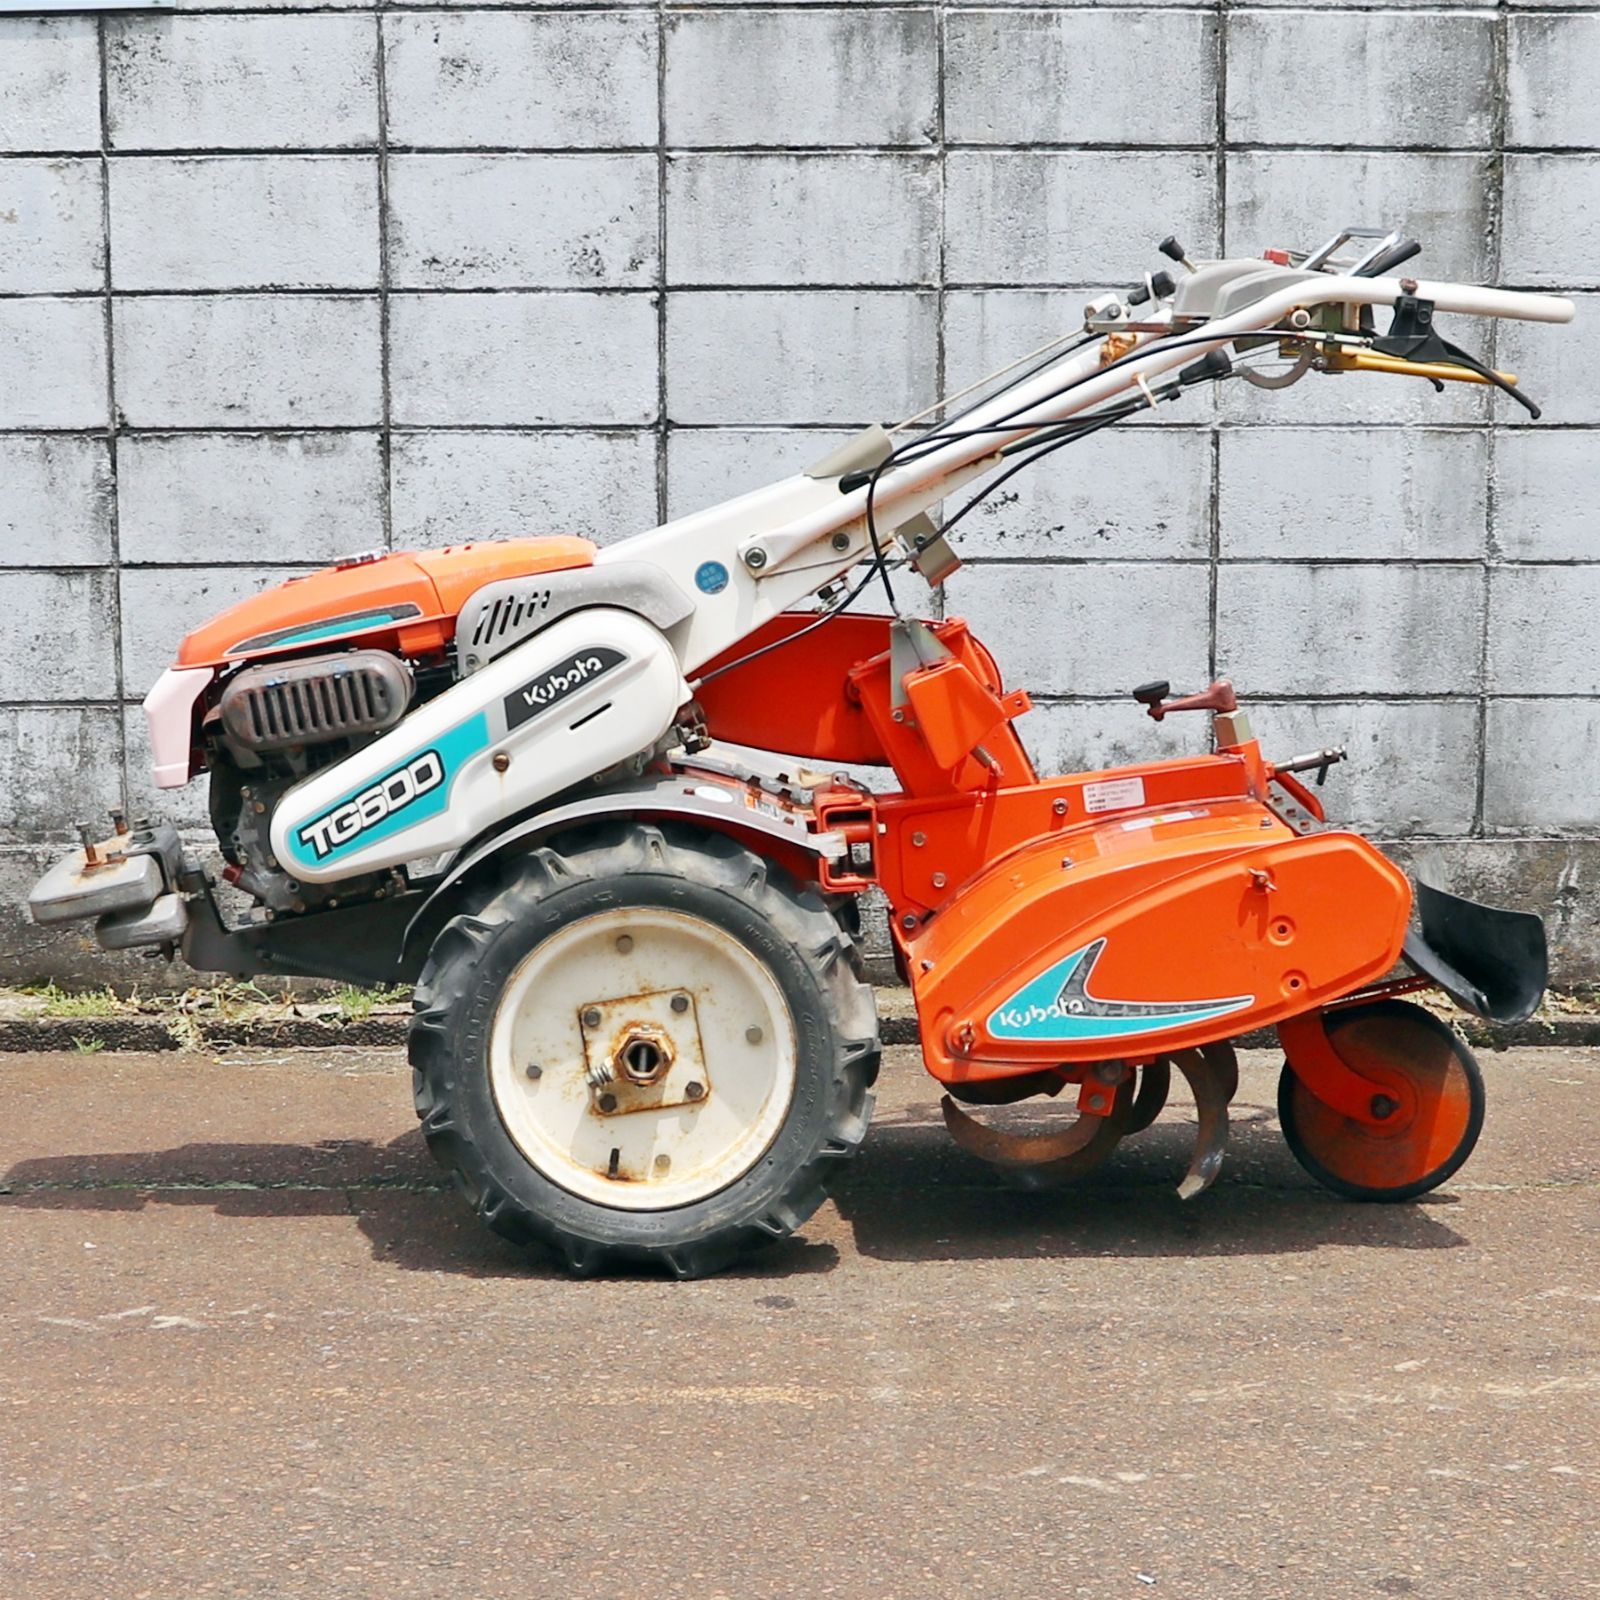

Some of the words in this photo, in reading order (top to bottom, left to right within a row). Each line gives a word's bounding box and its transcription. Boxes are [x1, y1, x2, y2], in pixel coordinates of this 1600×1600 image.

[522, 656, 603, 706] Kubota
[299, 751, 444, 857] TG600
[999, 996, 1085, 1029] Kubota
